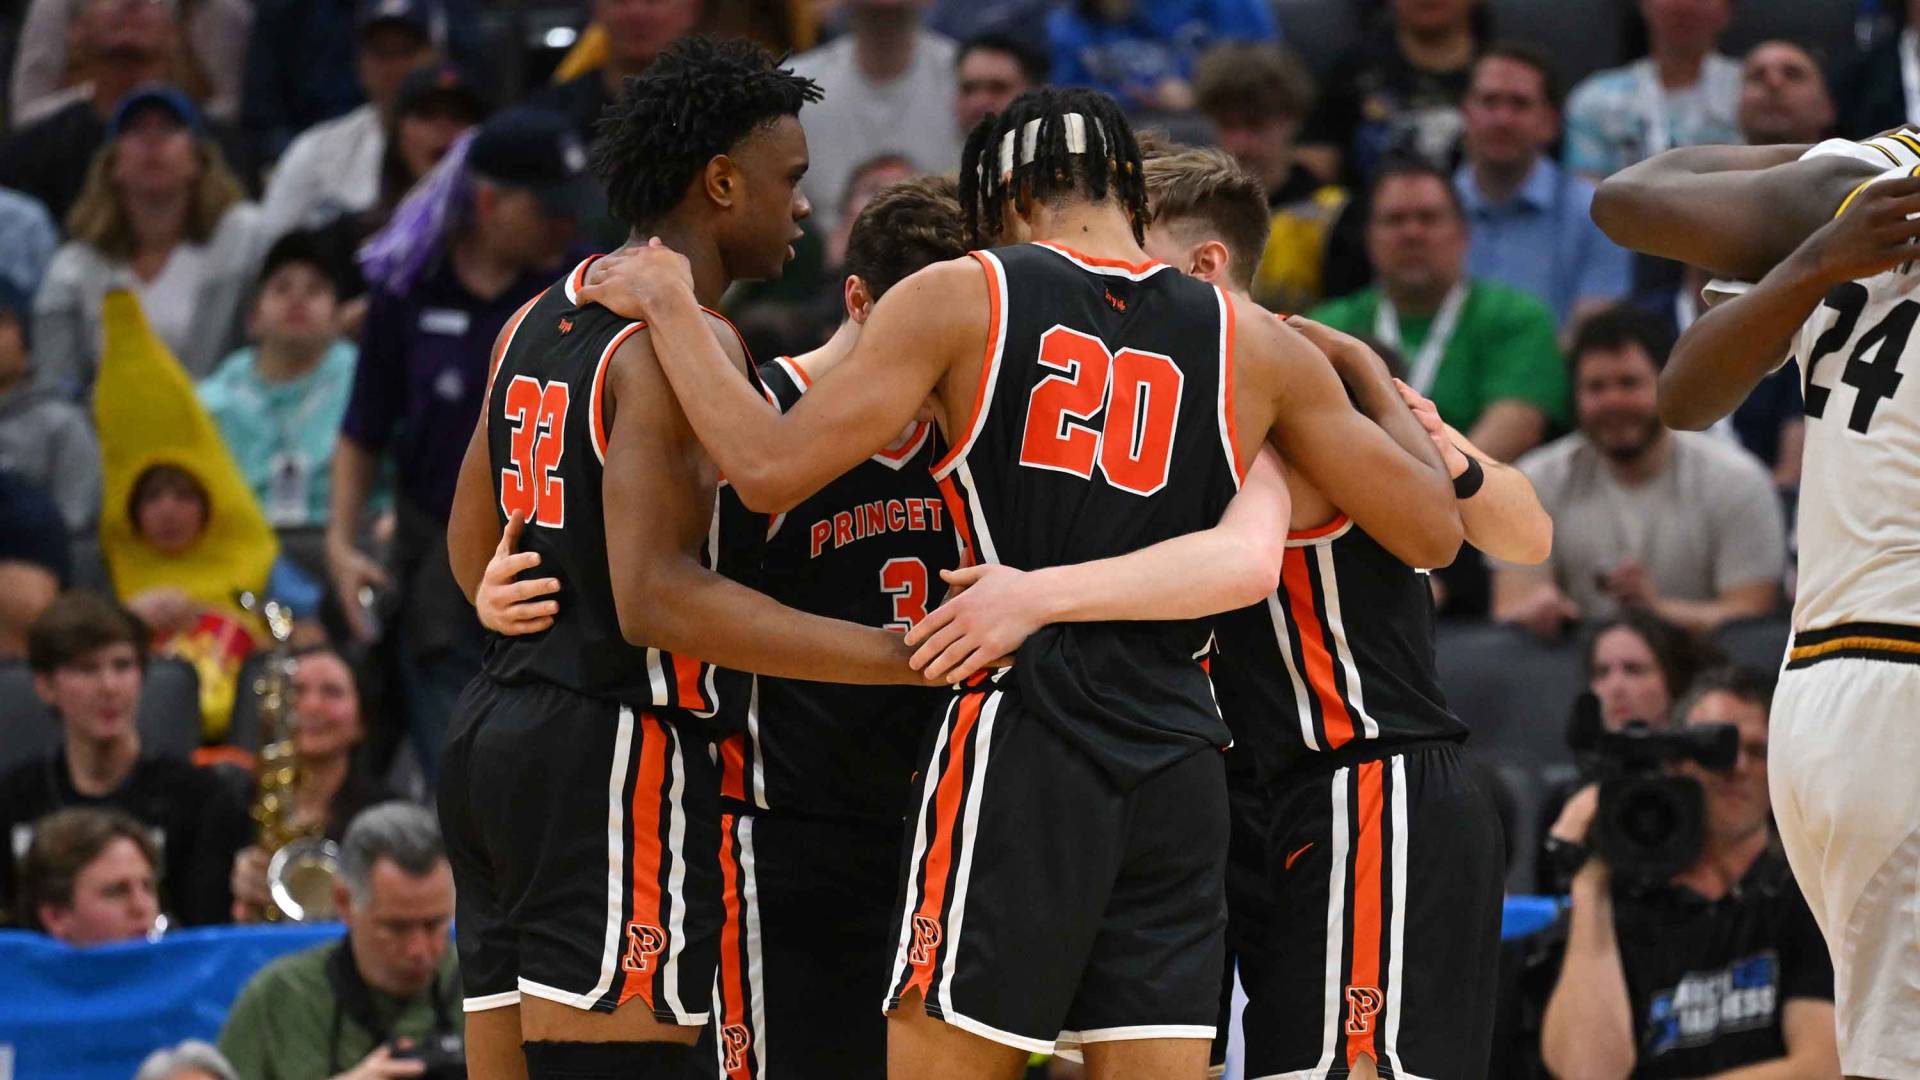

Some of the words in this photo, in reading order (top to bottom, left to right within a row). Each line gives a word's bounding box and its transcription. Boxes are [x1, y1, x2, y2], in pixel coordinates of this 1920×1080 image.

[1804, 281, 1920, 434] 24
[1019, 324, 1184, 497] 20
[501, 374, 569, 529] 32
[879, 557, 928, 633] 3
[623, 922, 666, 971] P
[909, 914, 942, 964] P
[1346, 986, 1383, 1034] P
[721, 1024, 750, 1071] P
